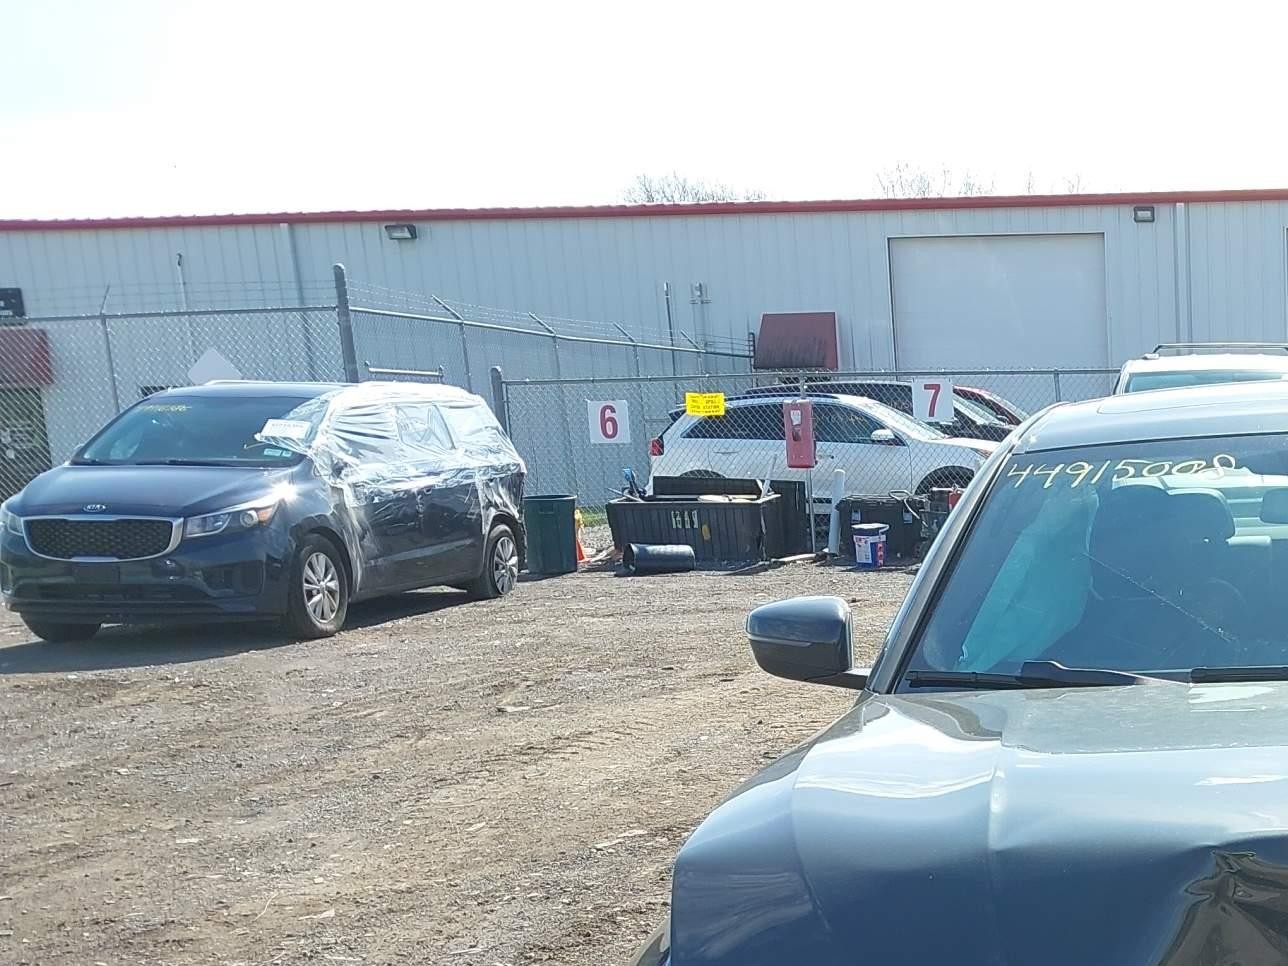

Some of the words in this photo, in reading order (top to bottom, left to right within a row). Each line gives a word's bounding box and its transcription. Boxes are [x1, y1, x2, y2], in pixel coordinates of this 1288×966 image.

[923, 383, 942, 418] 7
[599, 405, 619, 439] 6
[1007, 453, 1236, 489] 44915008
